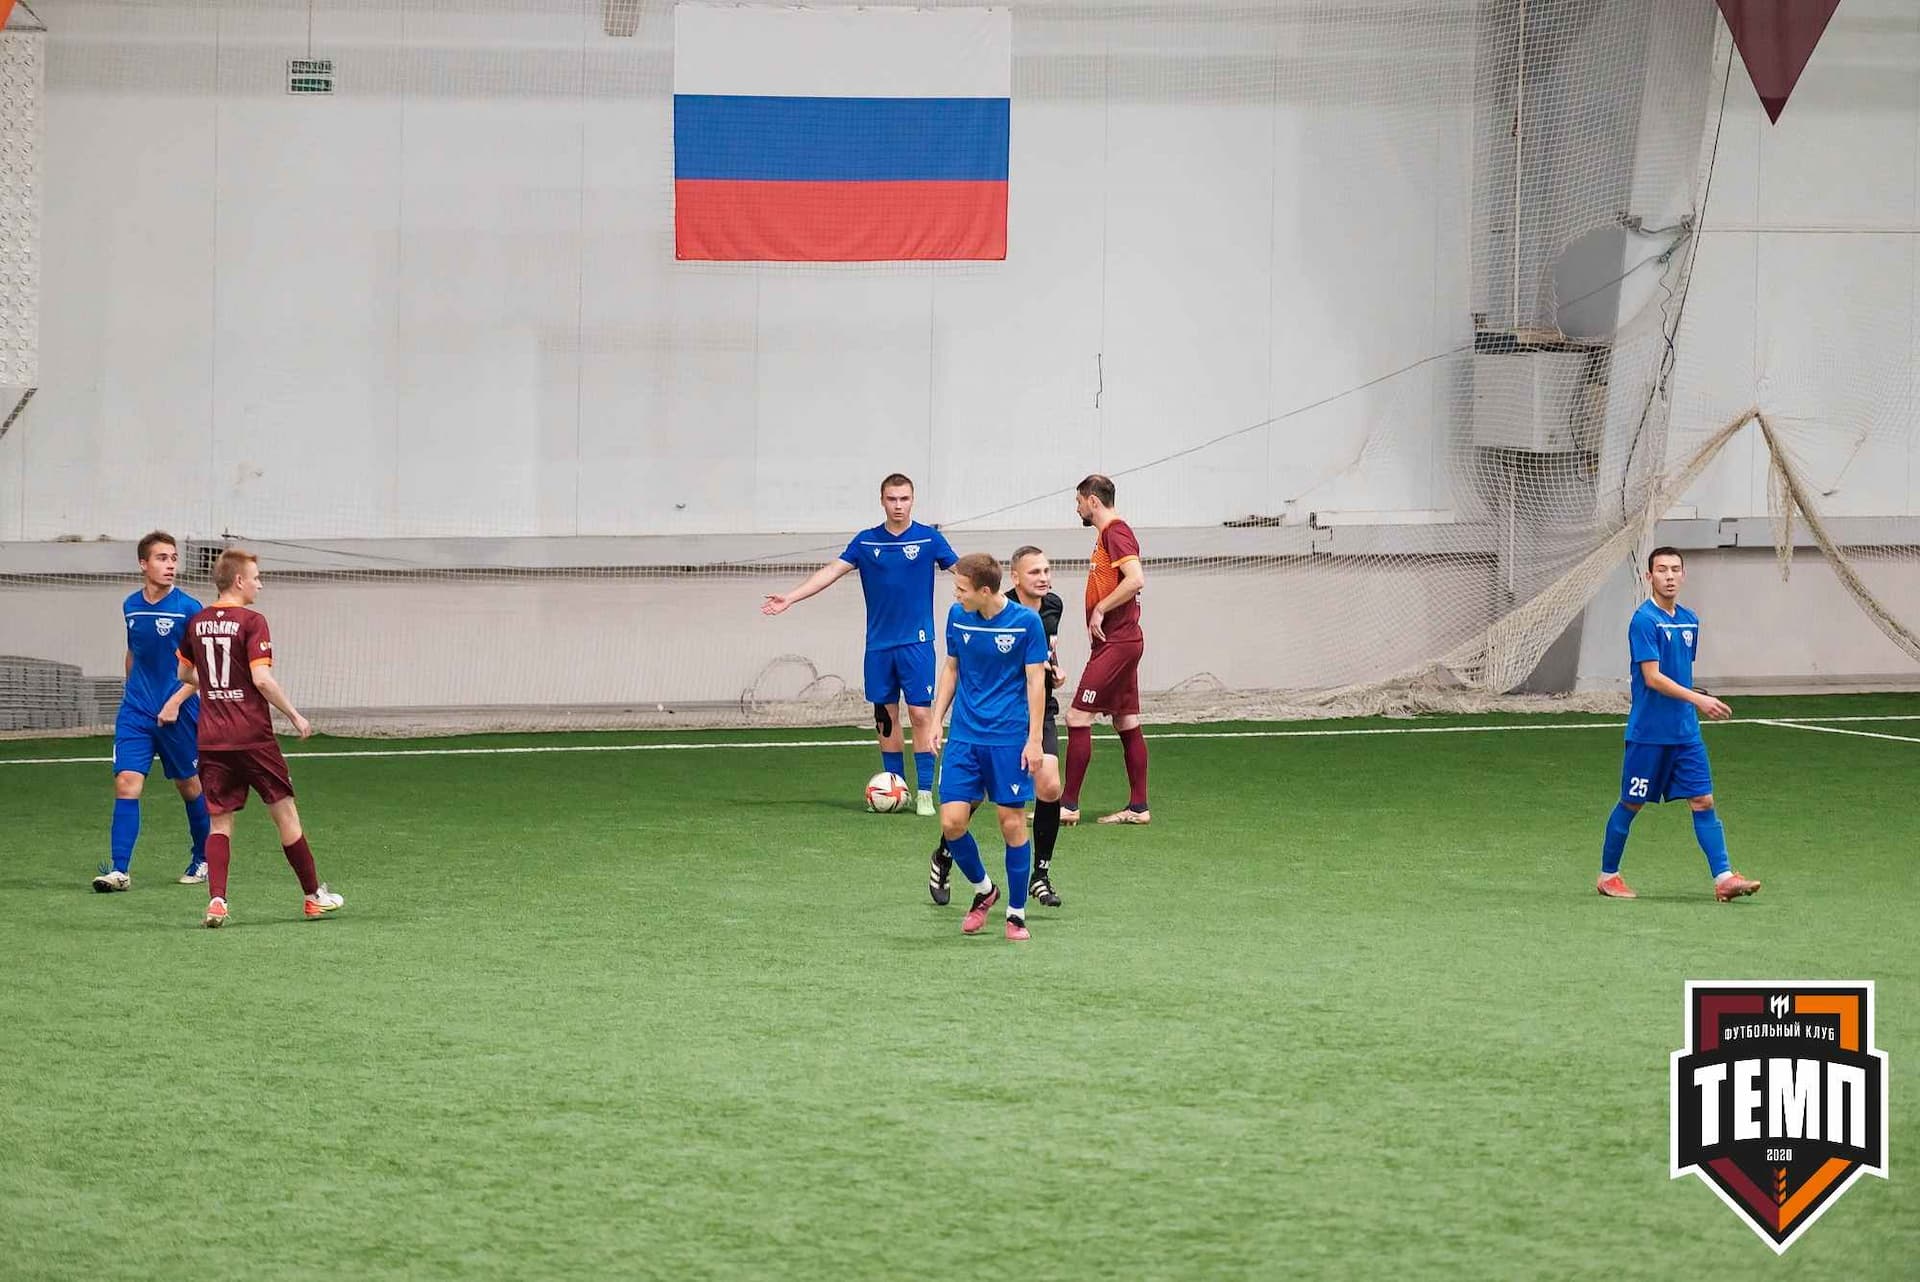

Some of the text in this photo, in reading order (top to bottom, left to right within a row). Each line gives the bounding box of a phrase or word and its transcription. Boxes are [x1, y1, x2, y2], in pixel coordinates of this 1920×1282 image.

[918, 629, 926, 643] 8
[201, 636, 232, 689] 17
[1082, 689, 1097, 704] 60
[1629, 776, 1649, 798] 25
